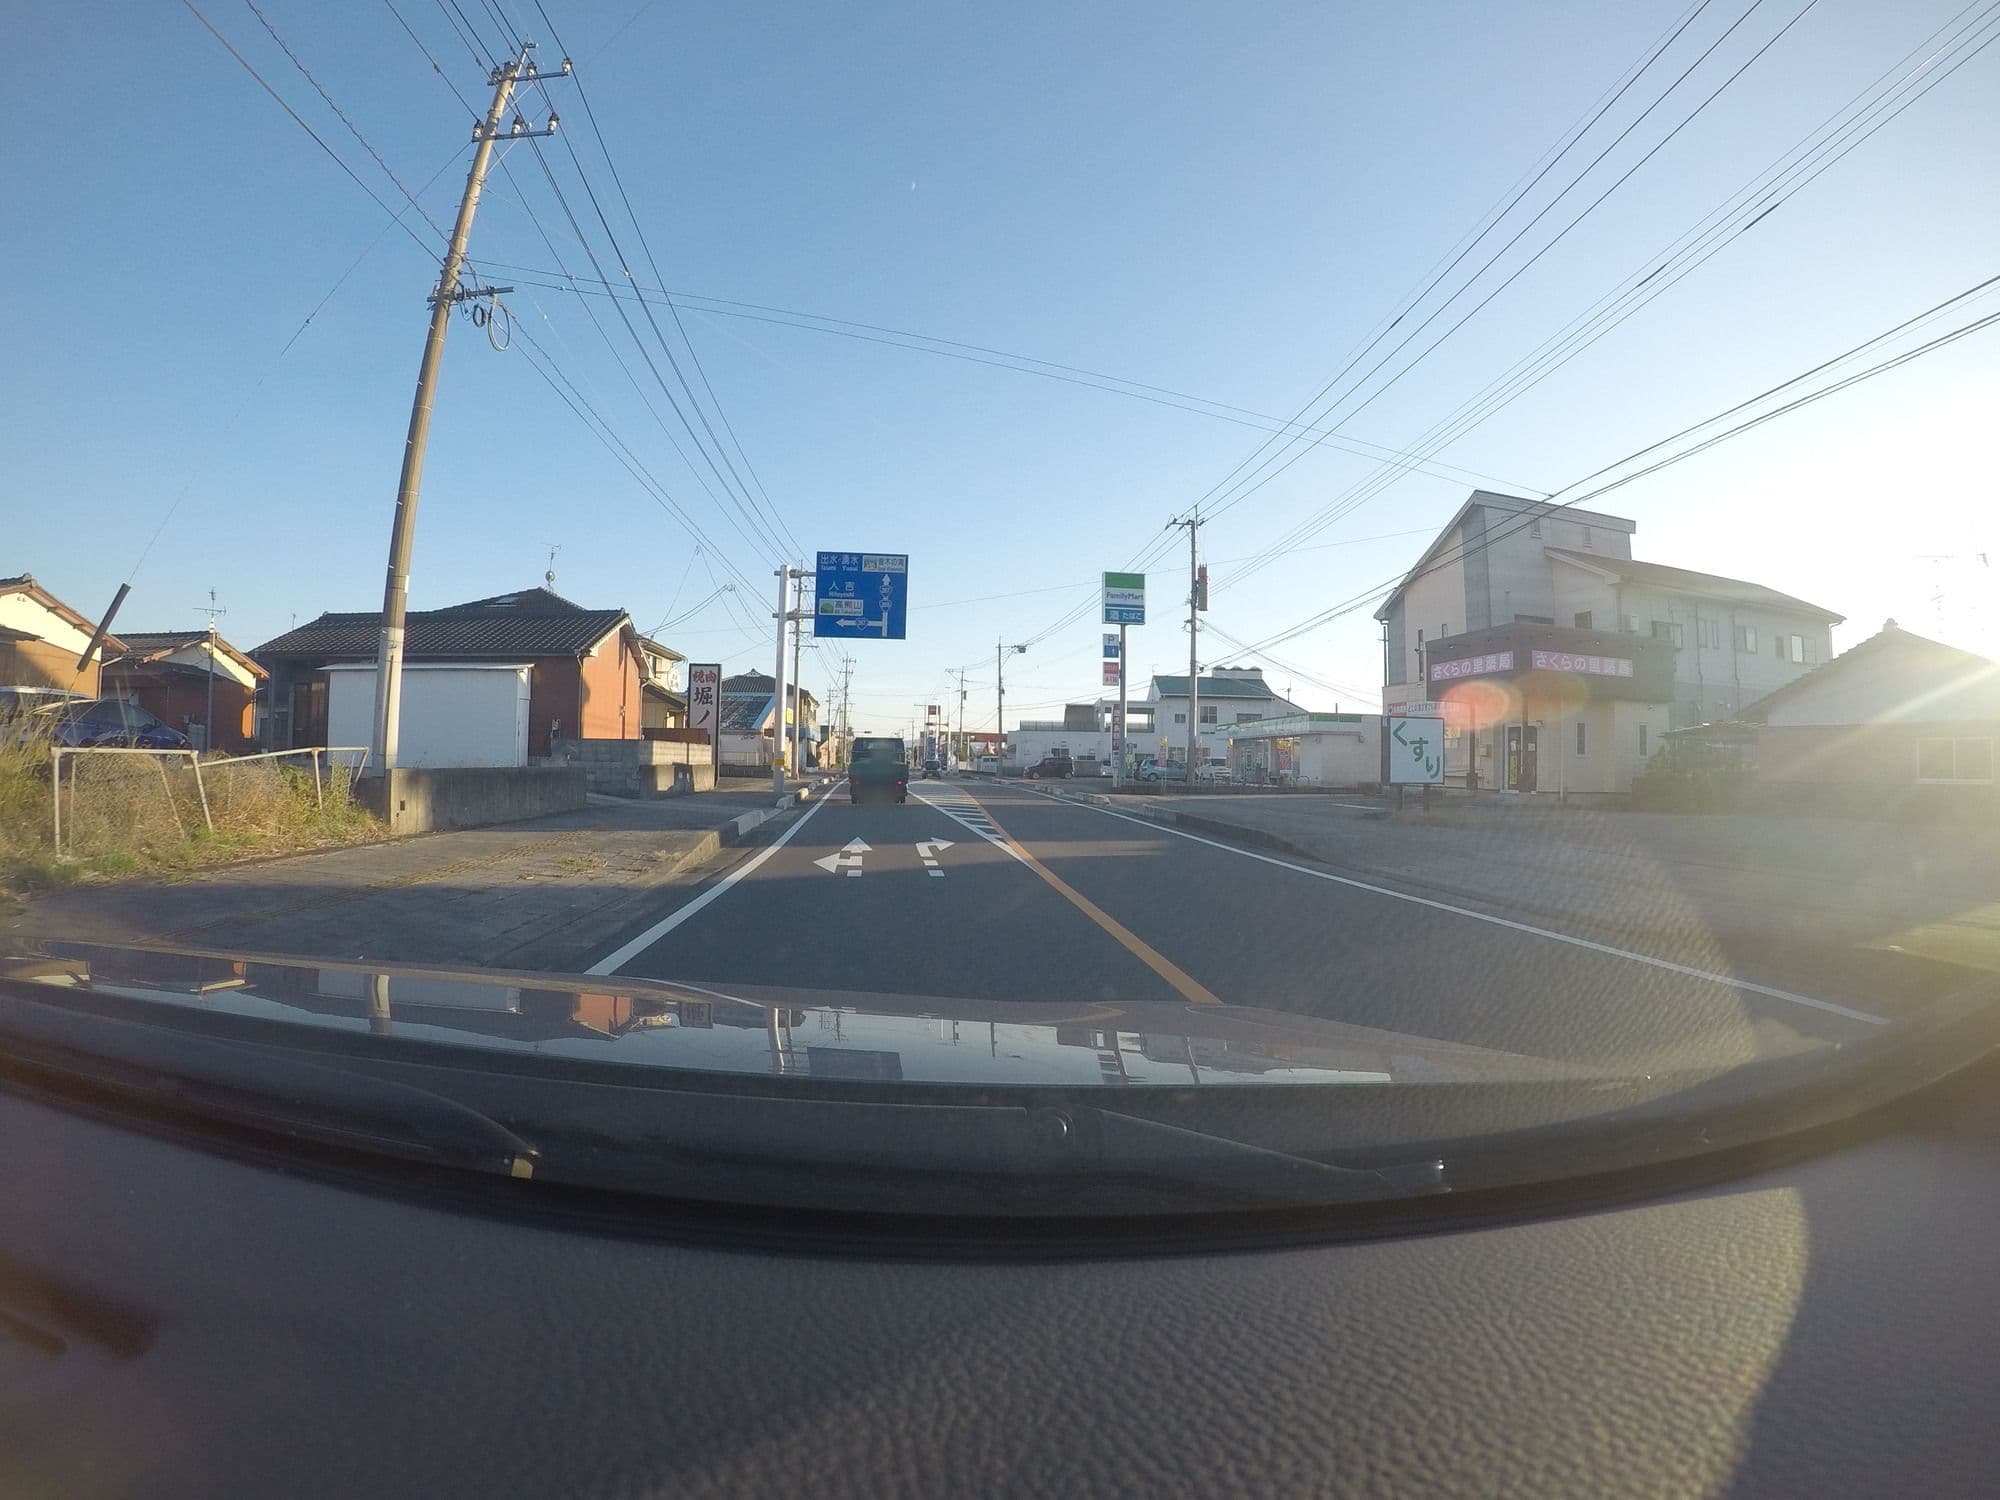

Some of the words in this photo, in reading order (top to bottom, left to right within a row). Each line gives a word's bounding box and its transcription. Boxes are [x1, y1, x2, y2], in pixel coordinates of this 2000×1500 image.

[1106, 591, 1144, 601] FamilyMart
[692, 670, 717, 684] 焼肉
[1392, 720, 1441, 779] くすり
